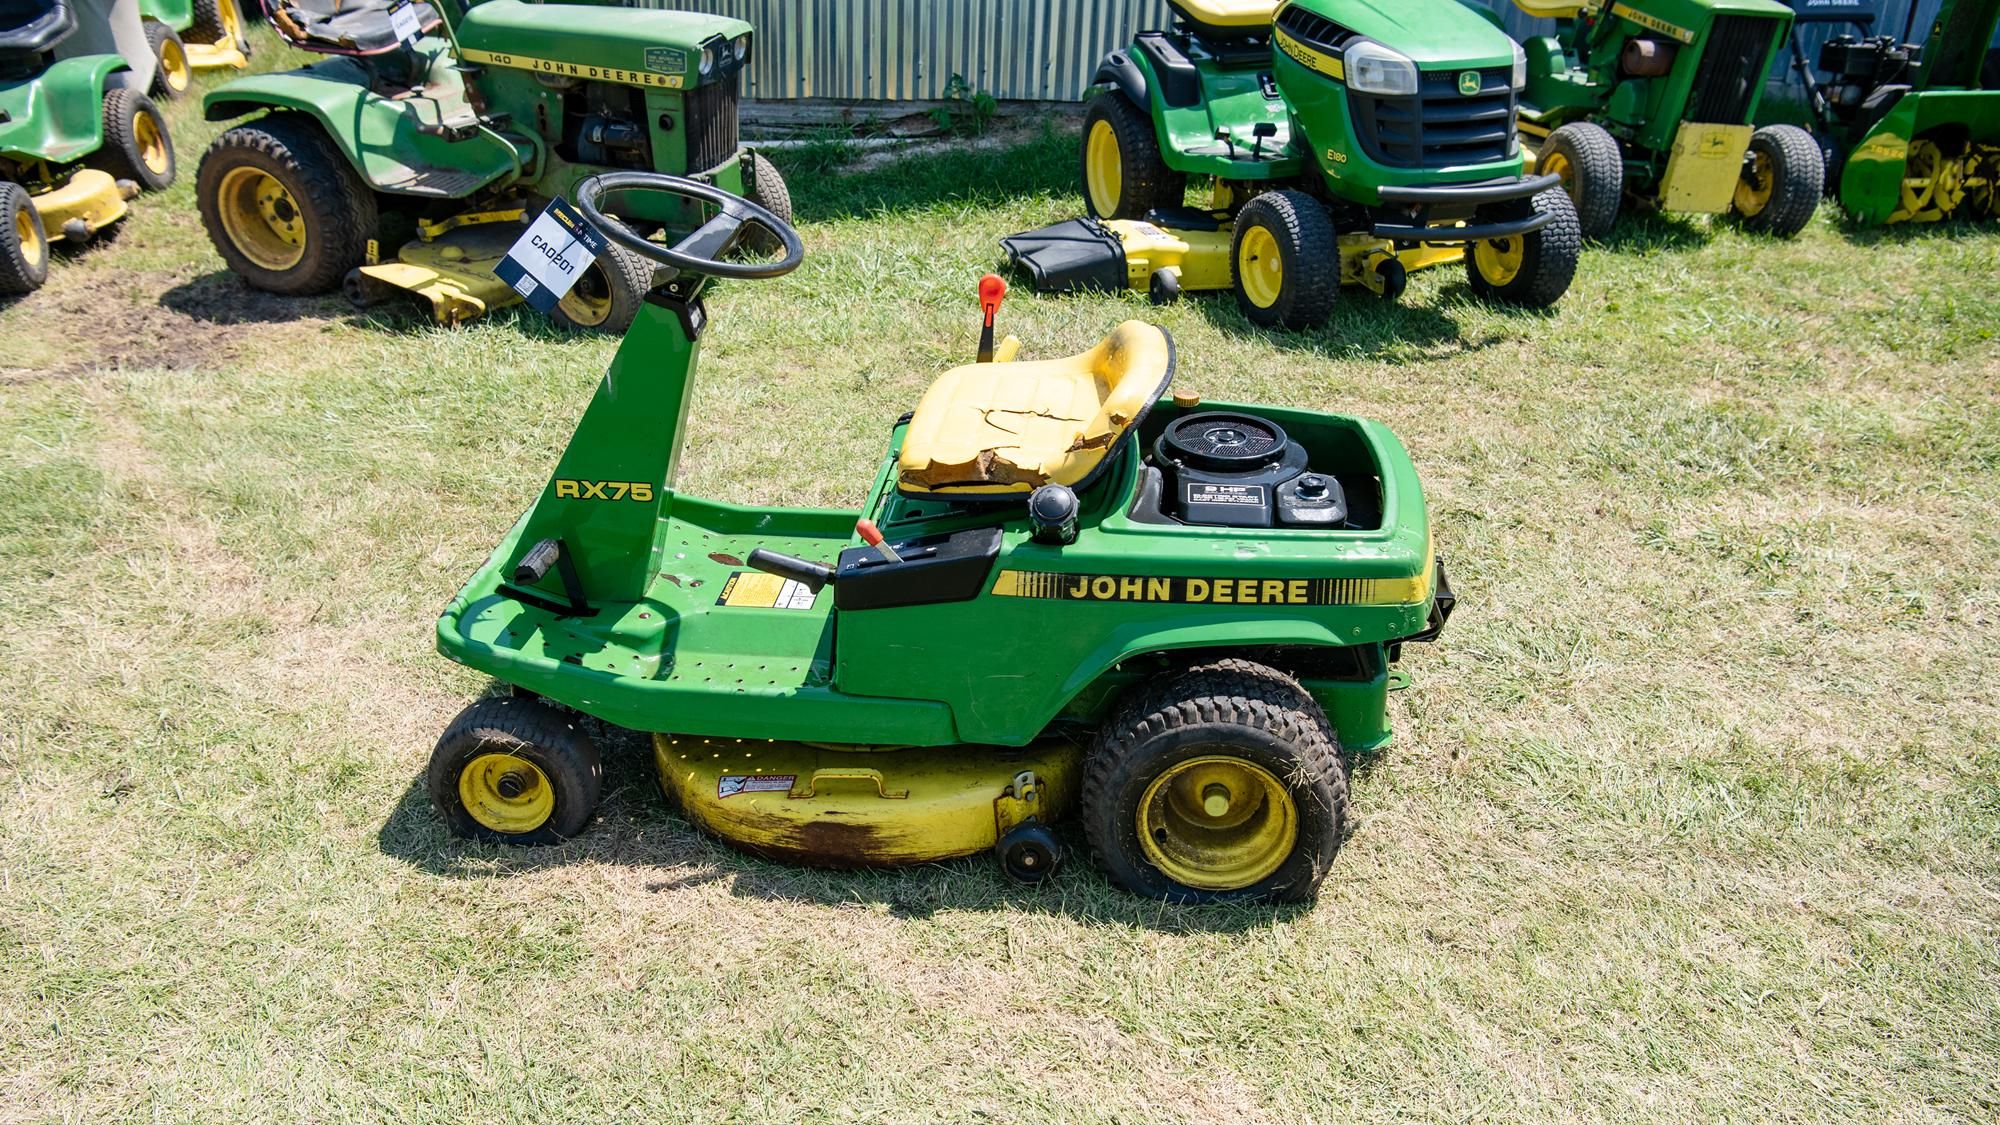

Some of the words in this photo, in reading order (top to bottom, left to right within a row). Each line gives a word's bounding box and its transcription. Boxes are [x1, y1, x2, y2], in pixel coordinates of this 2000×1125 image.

[1280, 34, 1295, 56] JOHN
[1294, 44, 1317, 68] DEERE
[488, 53, 512, 65] 140
[532, 60, 579, 75] JOHN
[590, 67, 652, 84] DEERE
[1327, 148, 1348, 163] E180
[583, 233, 599, 249] TIME
[555, 478, 654, 502] RX75
[1070, 576, 1171, 601] JOHN
[1185, 579, 1309, 604] DEERE
